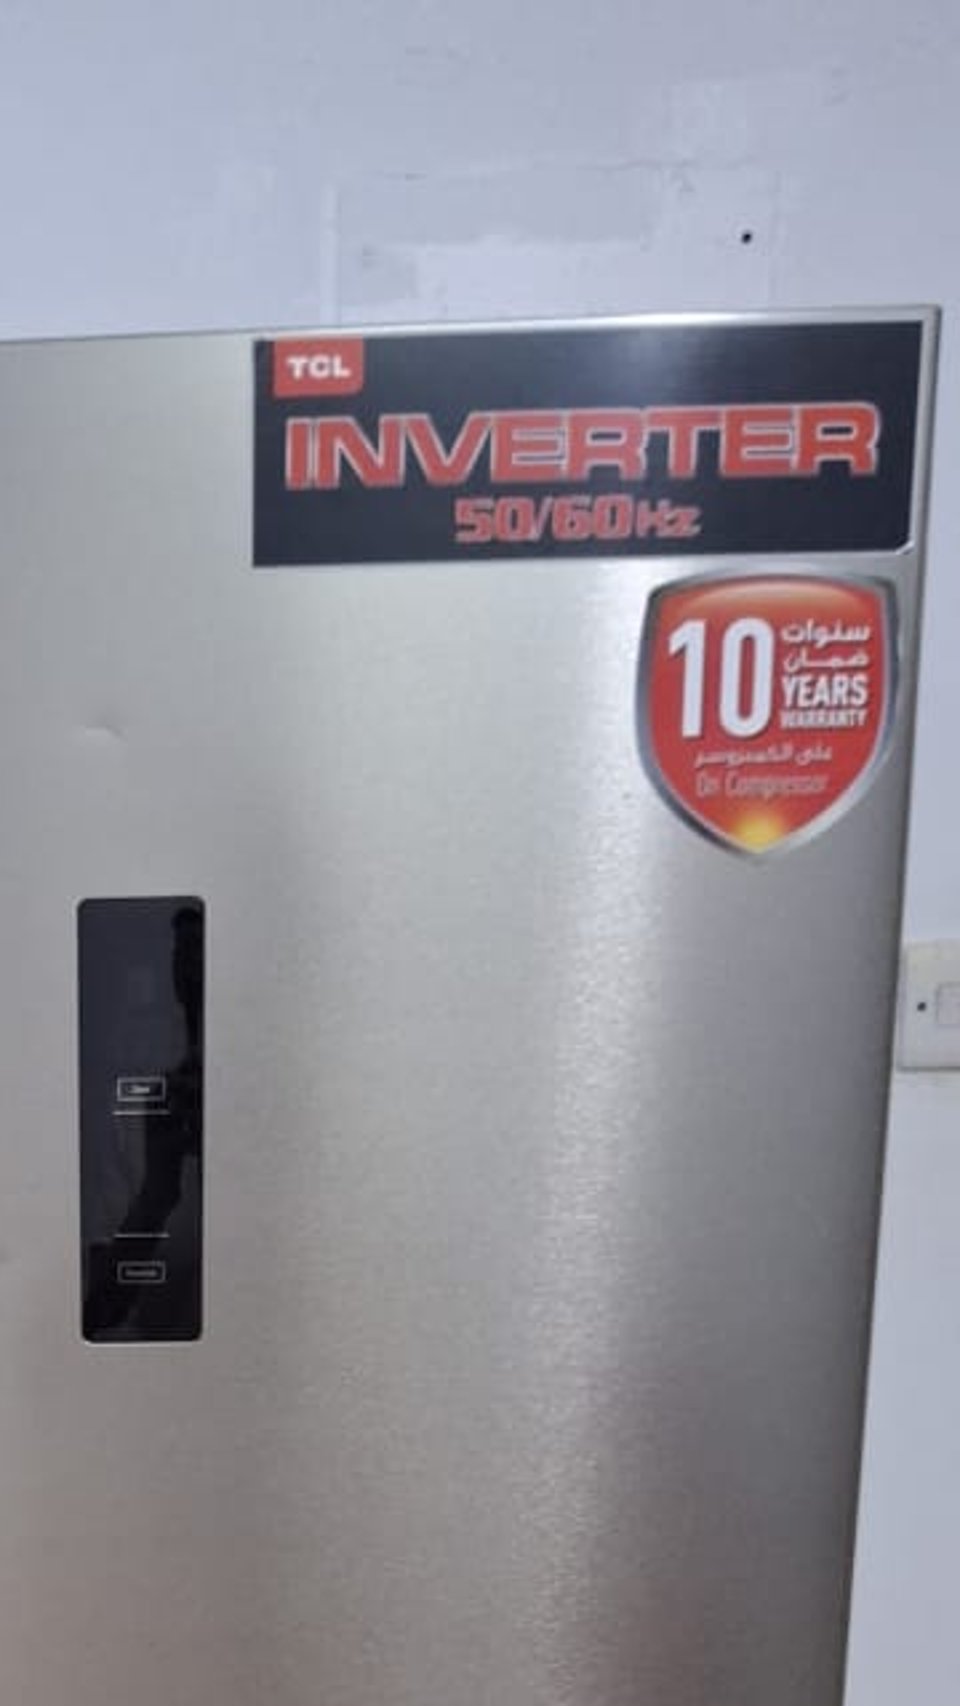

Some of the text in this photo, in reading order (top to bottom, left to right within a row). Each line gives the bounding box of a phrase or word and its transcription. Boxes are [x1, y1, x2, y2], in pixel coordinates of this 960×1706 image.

[287, 355, 351, 380] TCL
[285, 402, 880, 490] INVERTER
[781, 618, 872, 648] سنوات
[668, 617, 775, 738] 10
[781, 673, 869, 706] YEARS
[780, 709, 868, 730] WARRANTY
